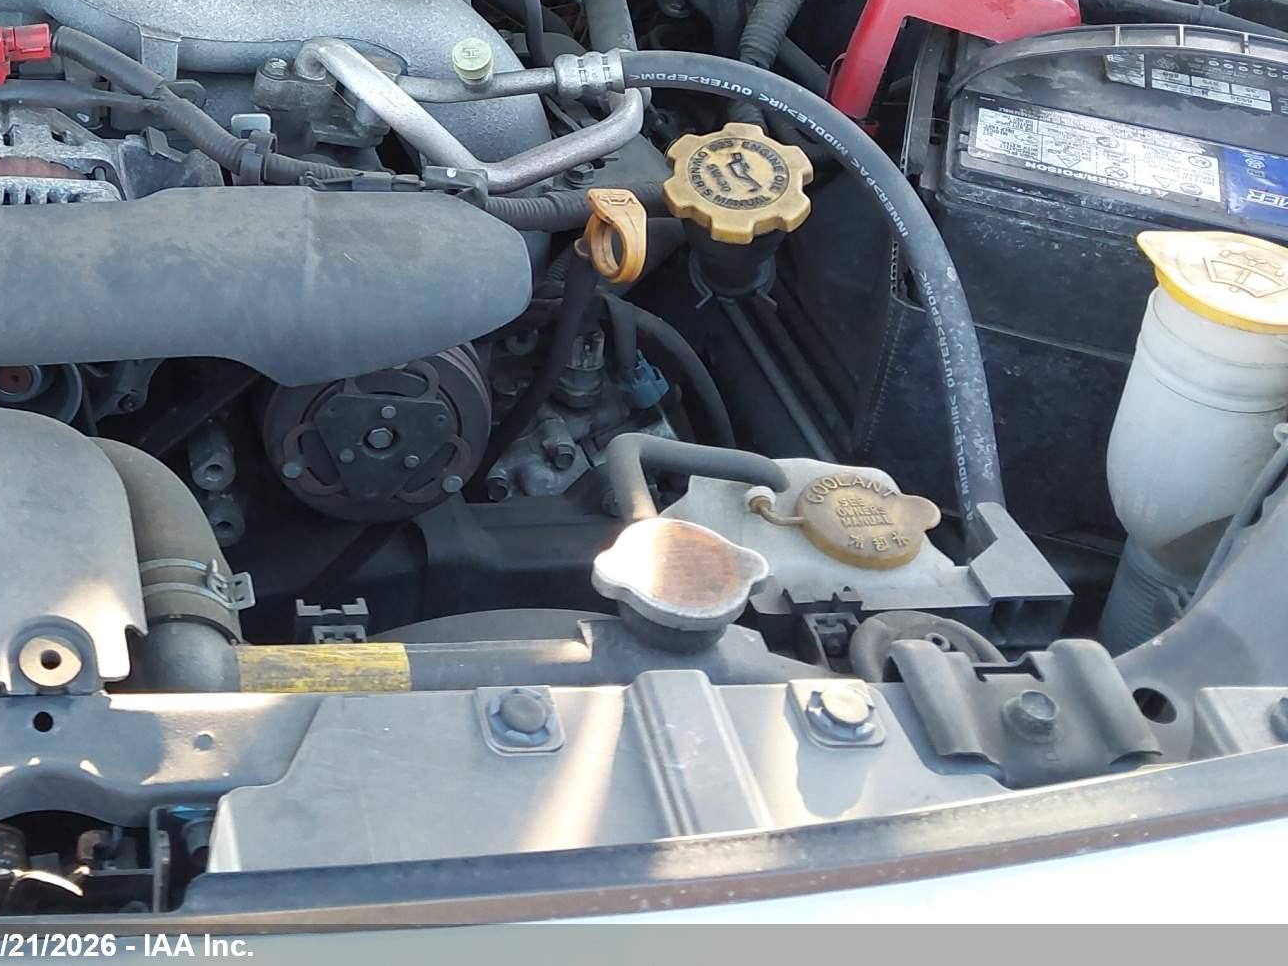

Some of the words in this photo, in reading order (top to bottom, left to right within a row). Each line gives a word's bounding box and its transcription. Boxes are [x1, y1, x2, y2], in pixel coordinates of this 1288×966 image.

[742, 141, 785, 173] ENGINE
[769, 174, 786, 193] OIL
[807, 474, 899, 505] COOLANT
[839, 497, 865, 507] SEE
[840, 516, 895, 529] MANUAL
